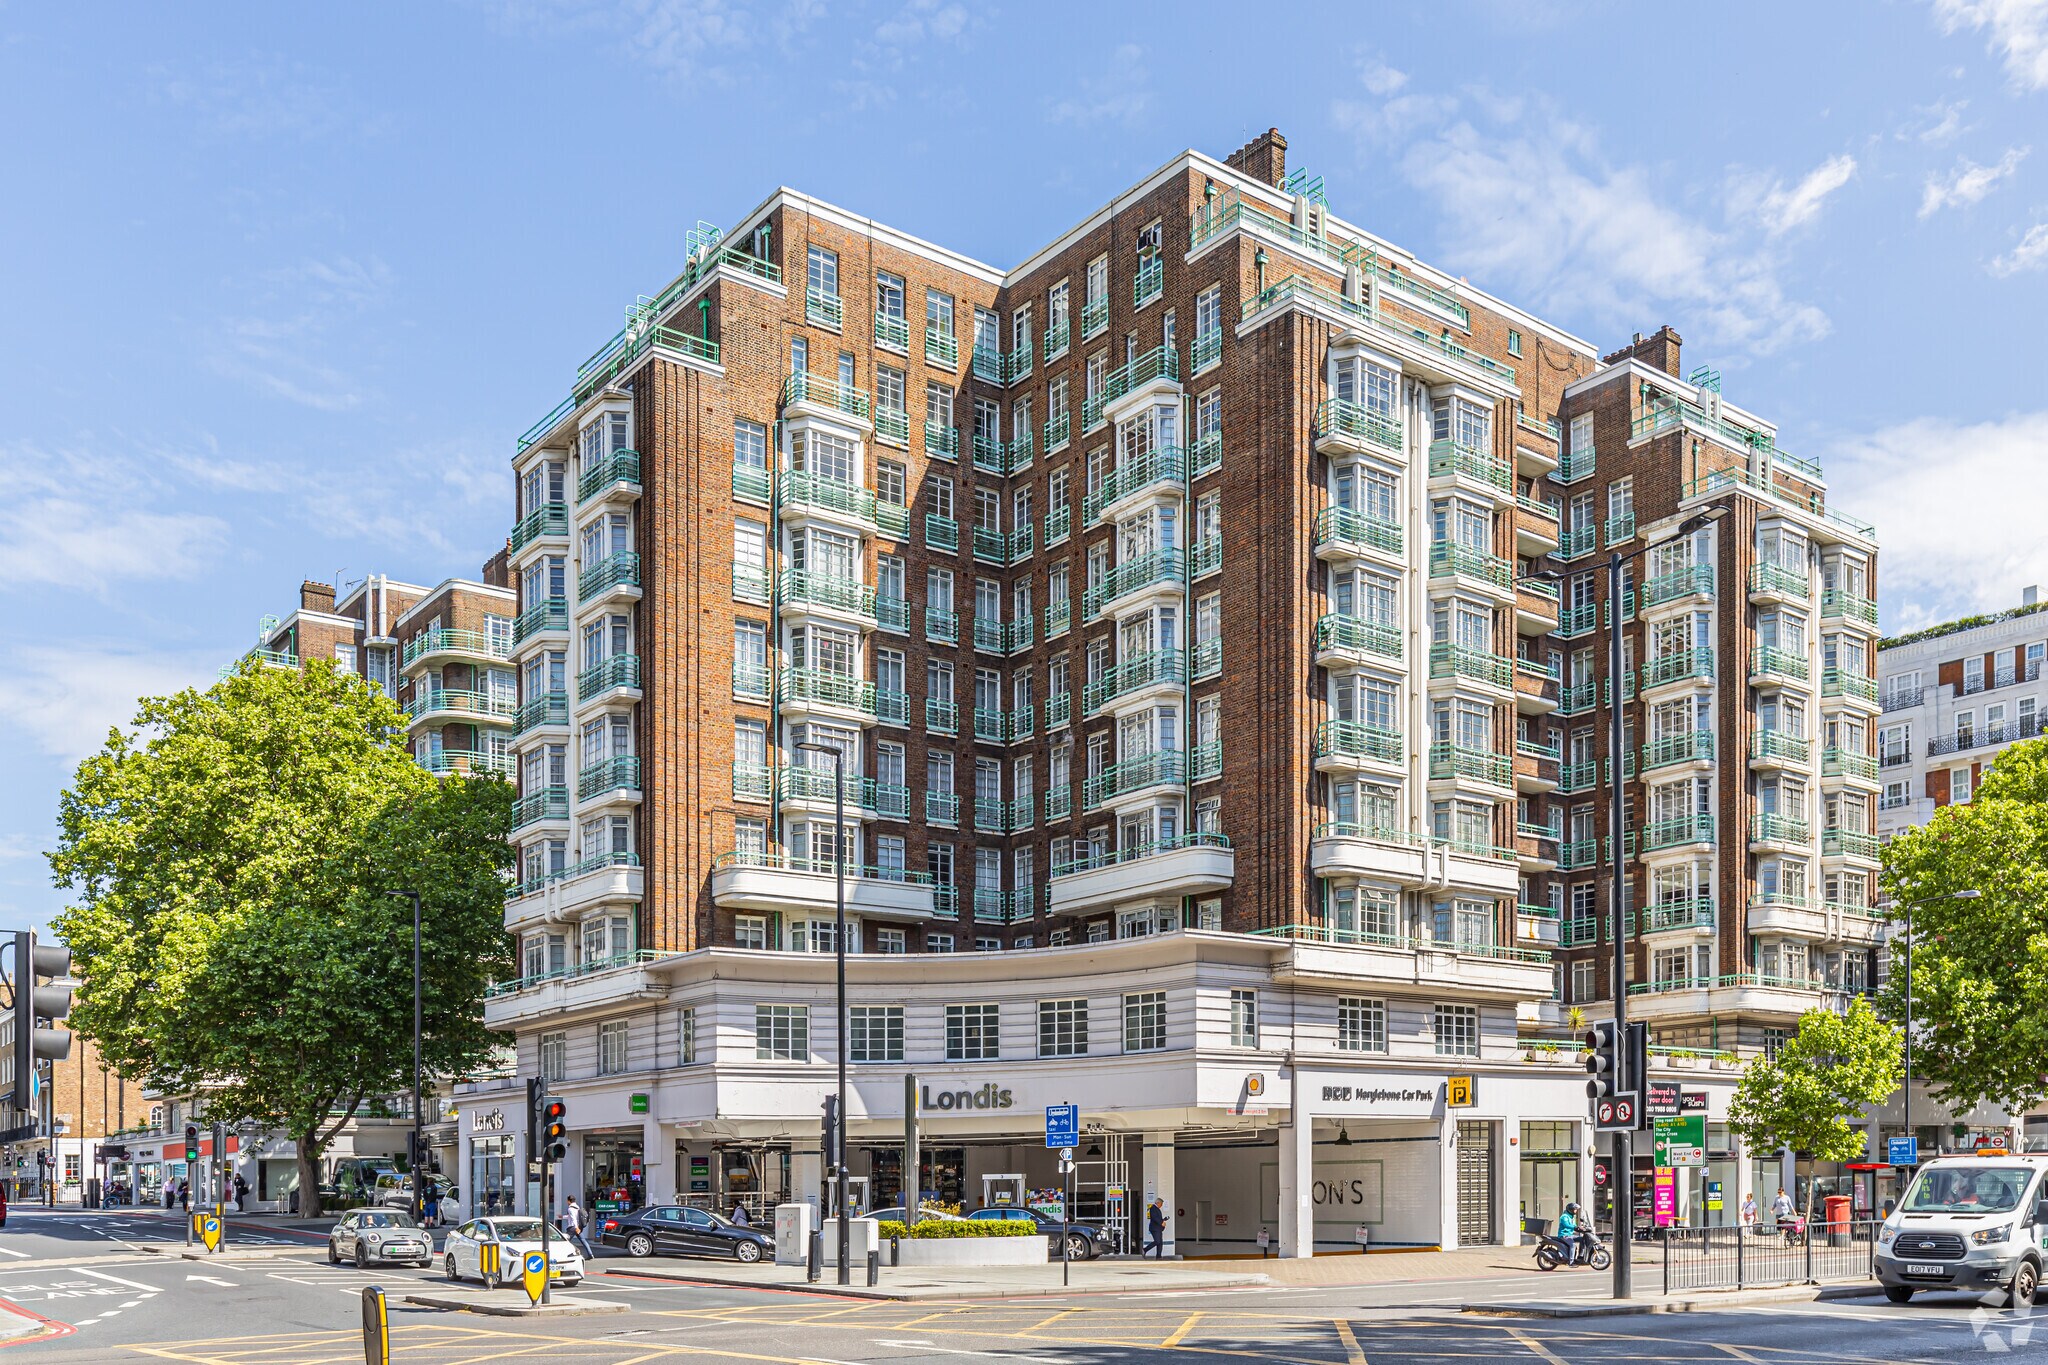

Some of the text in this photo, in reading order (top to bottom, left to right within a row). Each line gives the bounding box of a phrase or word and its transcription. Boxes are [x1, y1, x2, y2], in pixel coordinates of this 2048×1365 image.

[923, 1083, 1013, 1110] Londis
[1356, 1088, 1401, 1104] Marylebone
[1402, 1089, 1415, 1101] Car
[1416, 1090, 1433, 1101] Park
[1455, 1088, 1465, 1103] P
[1649, 1094, 1673, 1105] your door
[1657, 1166, 1672, 1175] WE ARE
[1312, 1180, 1363, 1204] ON'S
[1033, 1204, 1062, 1213] ondis
[0, 1281, 98, 1293] BUS
[2, 1286, 141, 1301] LANE
